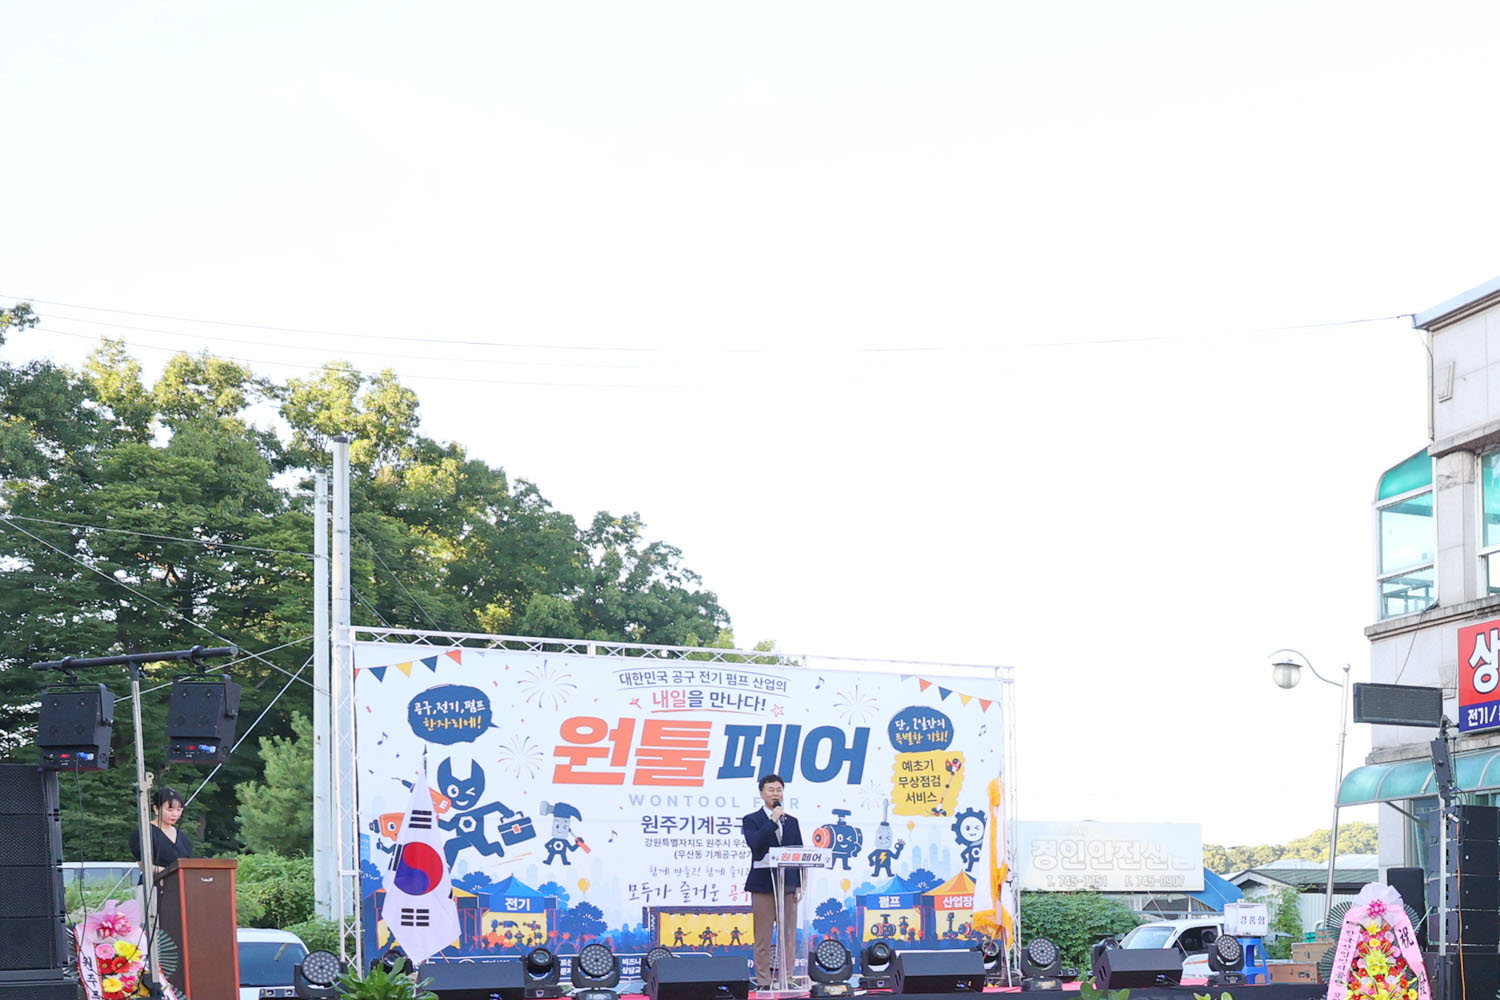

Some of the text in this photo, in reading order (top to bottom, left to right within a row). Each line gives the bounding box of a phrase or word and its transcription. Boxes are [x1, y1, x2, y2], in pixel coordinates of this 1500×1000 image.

[620, 671, 787, 692] 대한민국 공구 전기 펌프 산업의
[653, 689, 766, 711] 내일을 만나다!
[423, 717, 481, 731] 한자리에!
[902, 759, 934, 772] 예초기
[898, 775, 941, 789] 무상점검
[628, 794, 799, 810] WONTOOL FR
[905, 792, 937, 804] 서비스
[645, 838, 704, 848] 강원특별자치도
[706, 838, 731, 848] 원주시
[628, 882, 672, 903] 모두가
[680, 881, 719, 903] 즐거운
[504, 897, 531, 911] 전기
[878, 895, 901, 908] 펌프
[943, 895, 975, 908] 산업장
[1399, 926, 1414, 949] 祝
